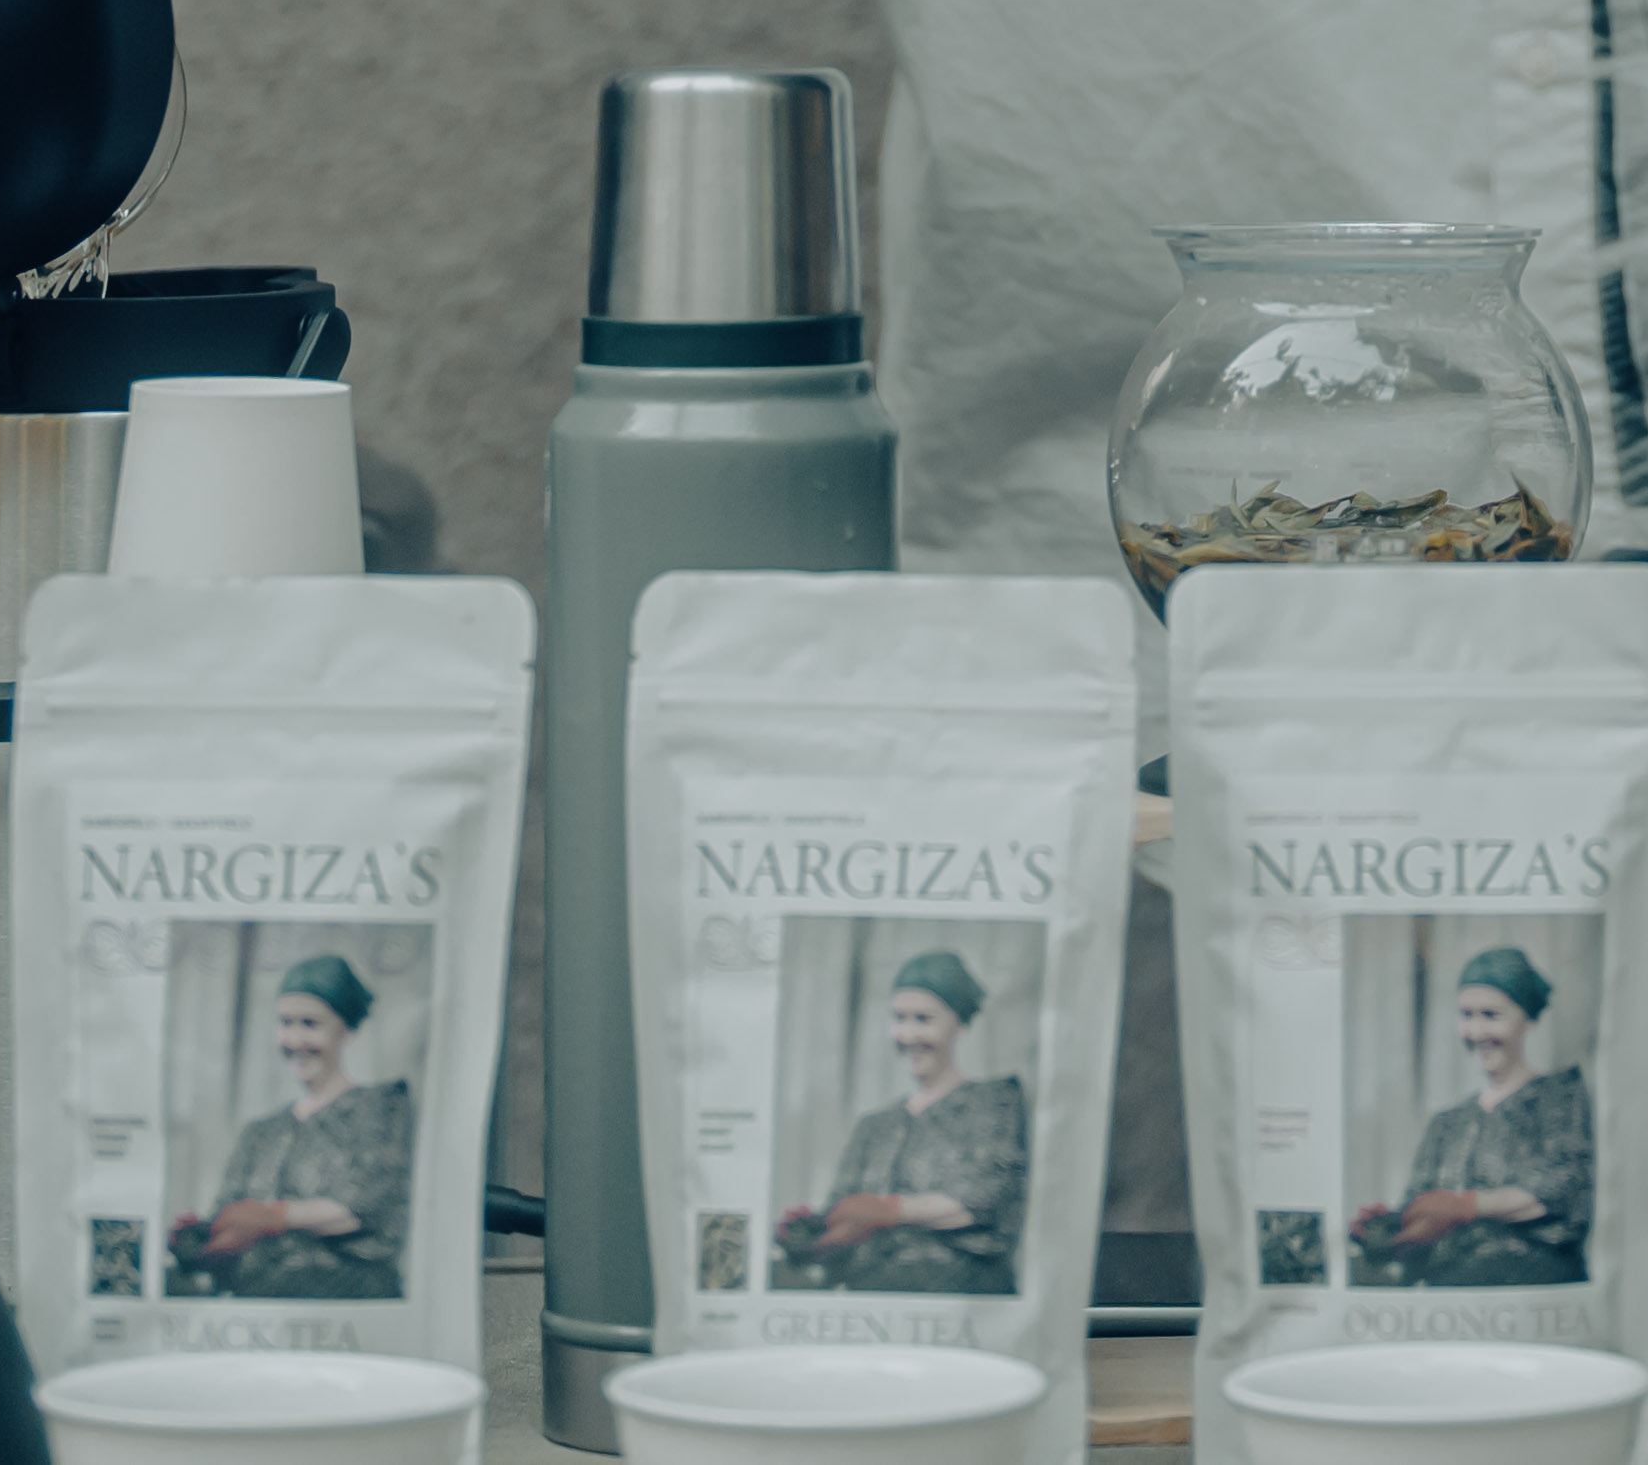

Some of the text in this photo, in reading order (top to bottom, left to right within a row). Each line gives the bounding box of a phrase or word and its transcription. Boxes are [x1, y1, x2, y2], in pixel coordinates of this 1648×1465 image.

[80, 841, 443, 906] NARGIZA'S
[695, 839, 1055, 904] NARGIZA'S
[1247, 833, 1611, 898] NARGIZA'S
[760, 1308, 984, 1349] GREEN TEA
[1342, 1302, 1594, 1341] OOLONG TEA
